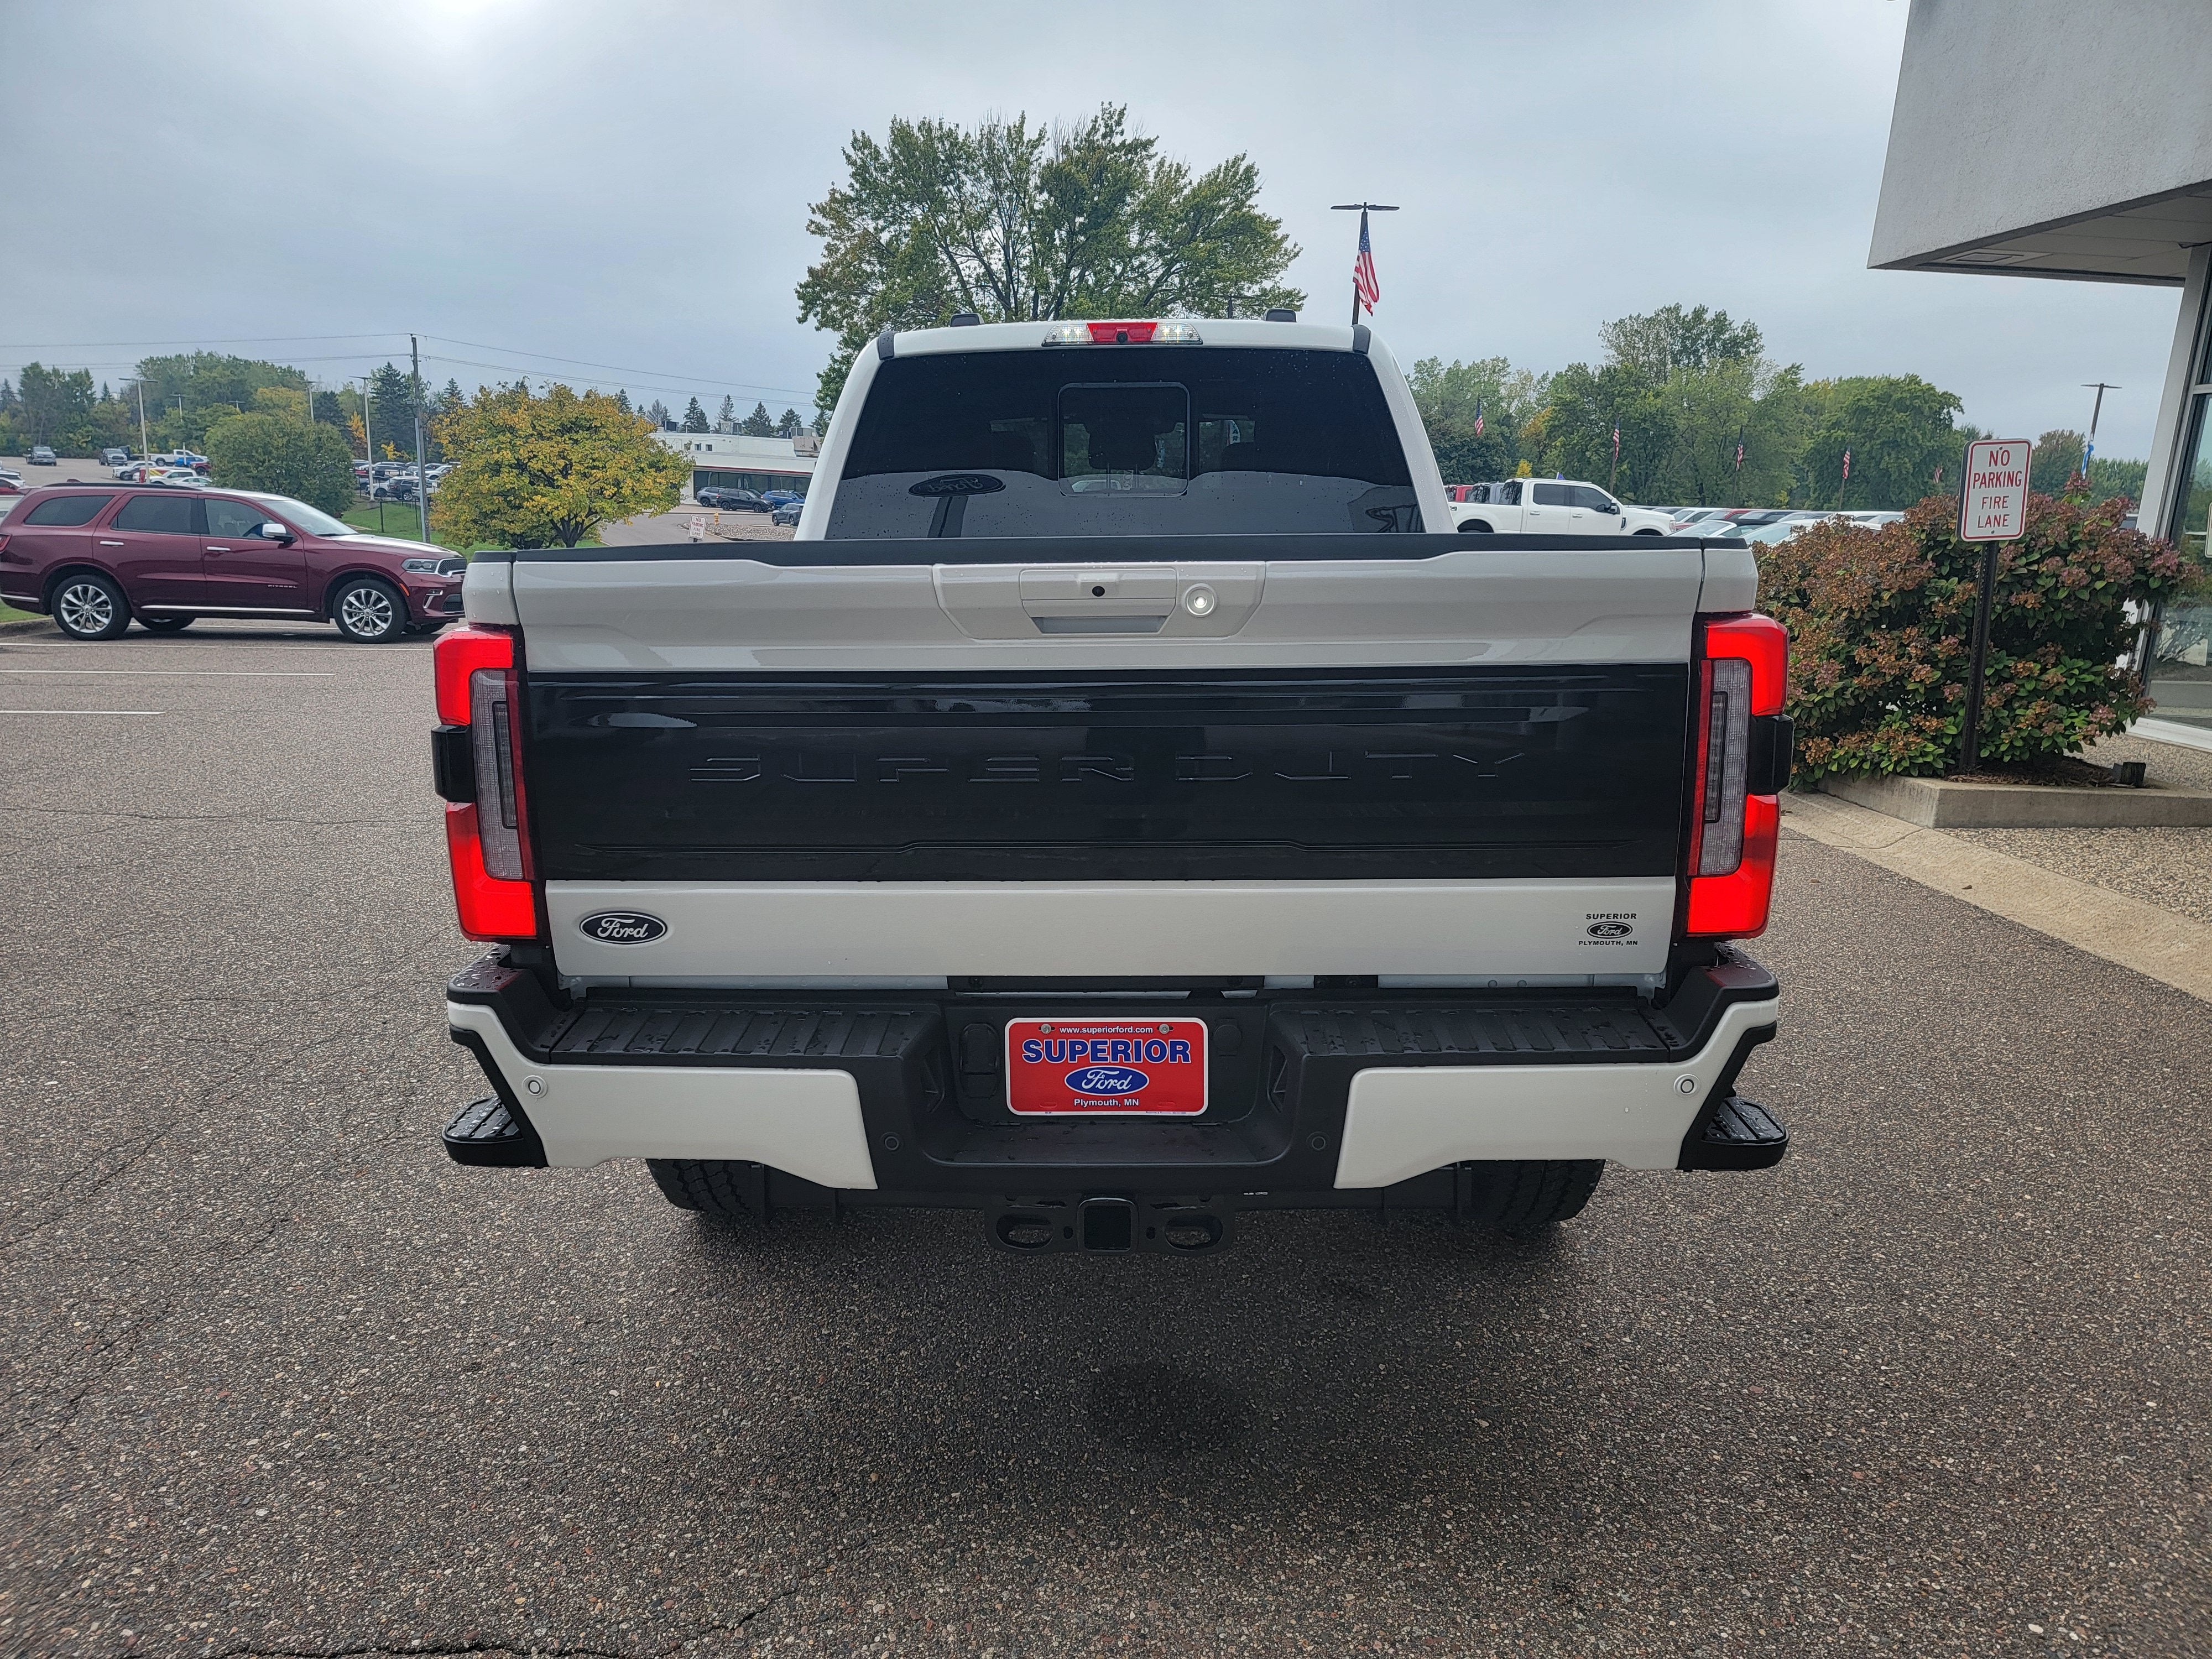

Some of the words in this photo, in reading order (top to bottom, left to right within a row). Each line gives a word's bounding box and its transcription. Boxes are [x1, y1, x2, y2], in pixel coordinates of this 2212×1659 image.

[1989, 450, 2010, 467] NO
[1973, 471, 2022, 489] PARKING
[1981, 495, 2010, 510] FIRE
[1977, 514, 2010, 528] LANE
[688, 753, 1134, 782] SUPER
[1176, 751, 1525, 781] DUTY
[597, 917, 649, 938] Ford
[1597, 925, 1623, 935] Ford
[1060, 1026, 1153, 1034] www.superiorford.com
[1022, 1039, 1191, 1063] SUPERIOR
[1081, 1069, 1132, 1091] Ford
[1074, 1099, 1121, 1107] Plymouth,
